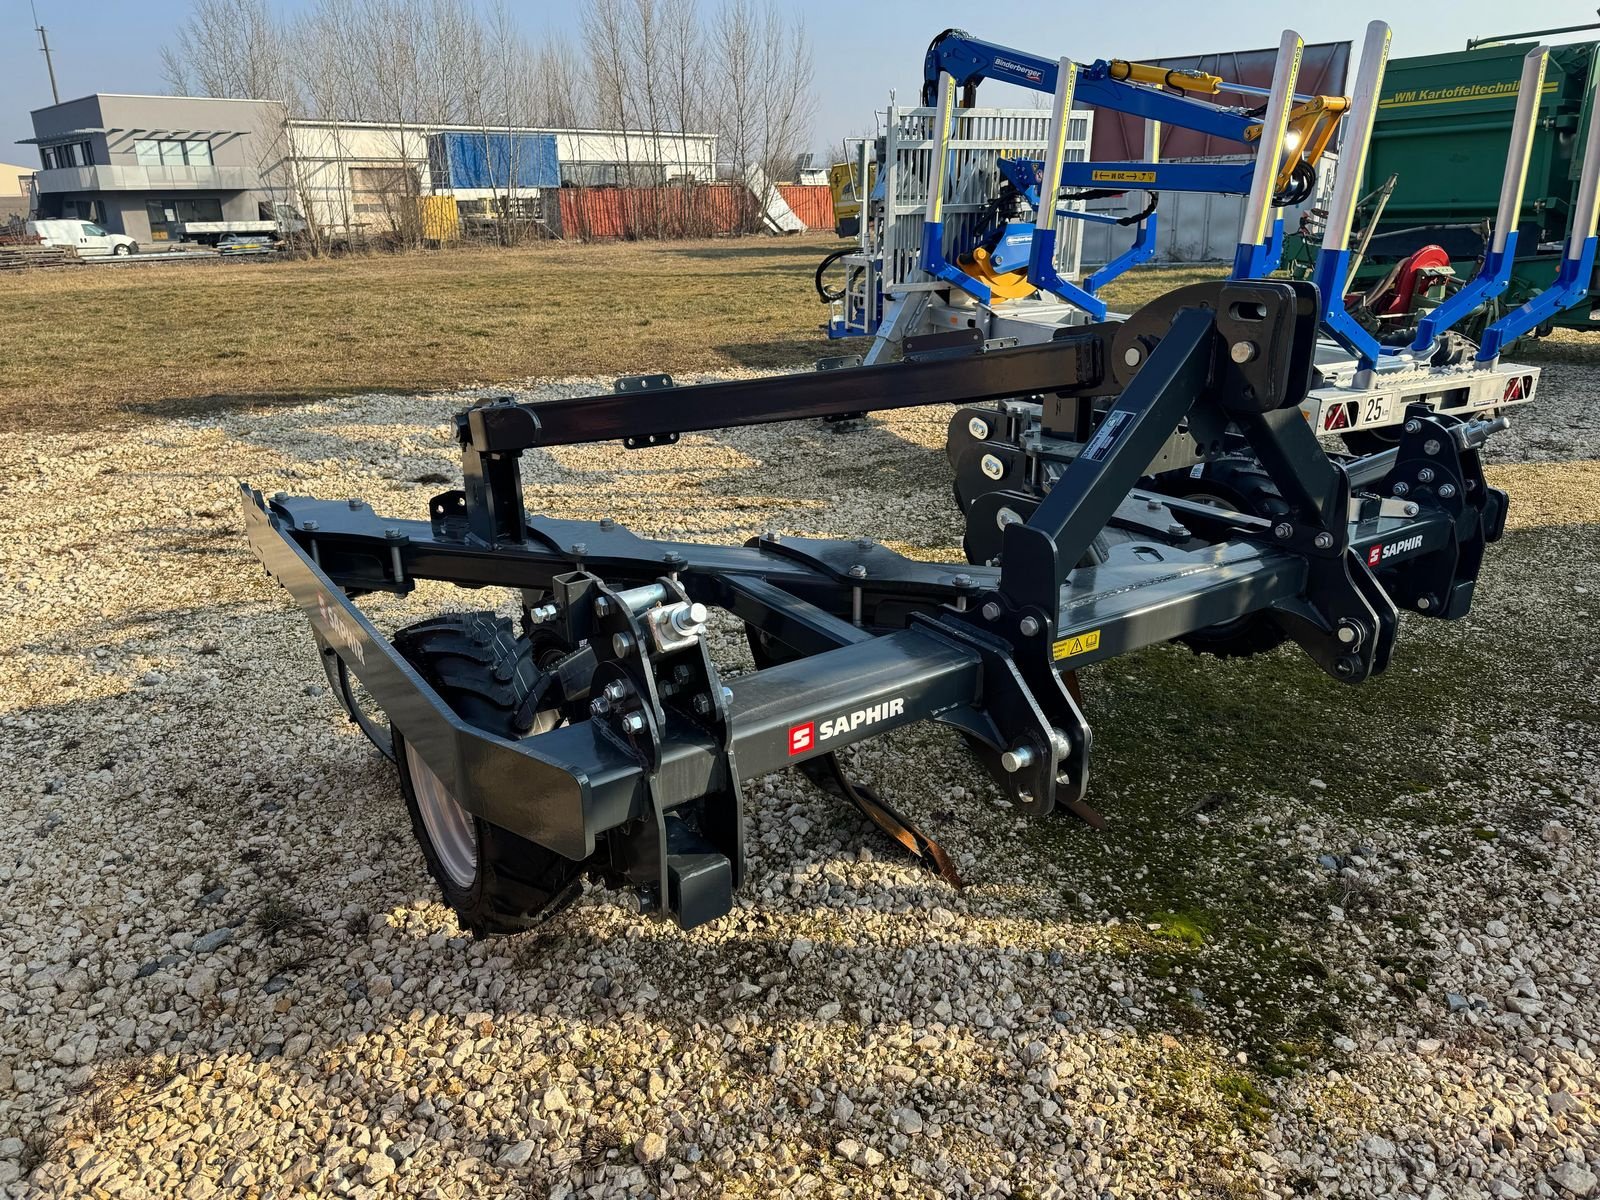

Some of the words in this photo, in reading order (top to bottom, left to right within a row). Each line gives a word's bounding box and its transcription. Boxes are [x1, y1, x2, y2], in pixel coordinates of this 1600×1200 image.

[994, 58, 1042, 77] Binderberger
[1395, 91, 1416, 103] WM
[1365, 397, 1384, 422] 25
[1381, 535, 1423, 559] SAPHIR
[327, 606, 366, 667] SAPHIR
[819, 697, 904, 741] SAPHIR
